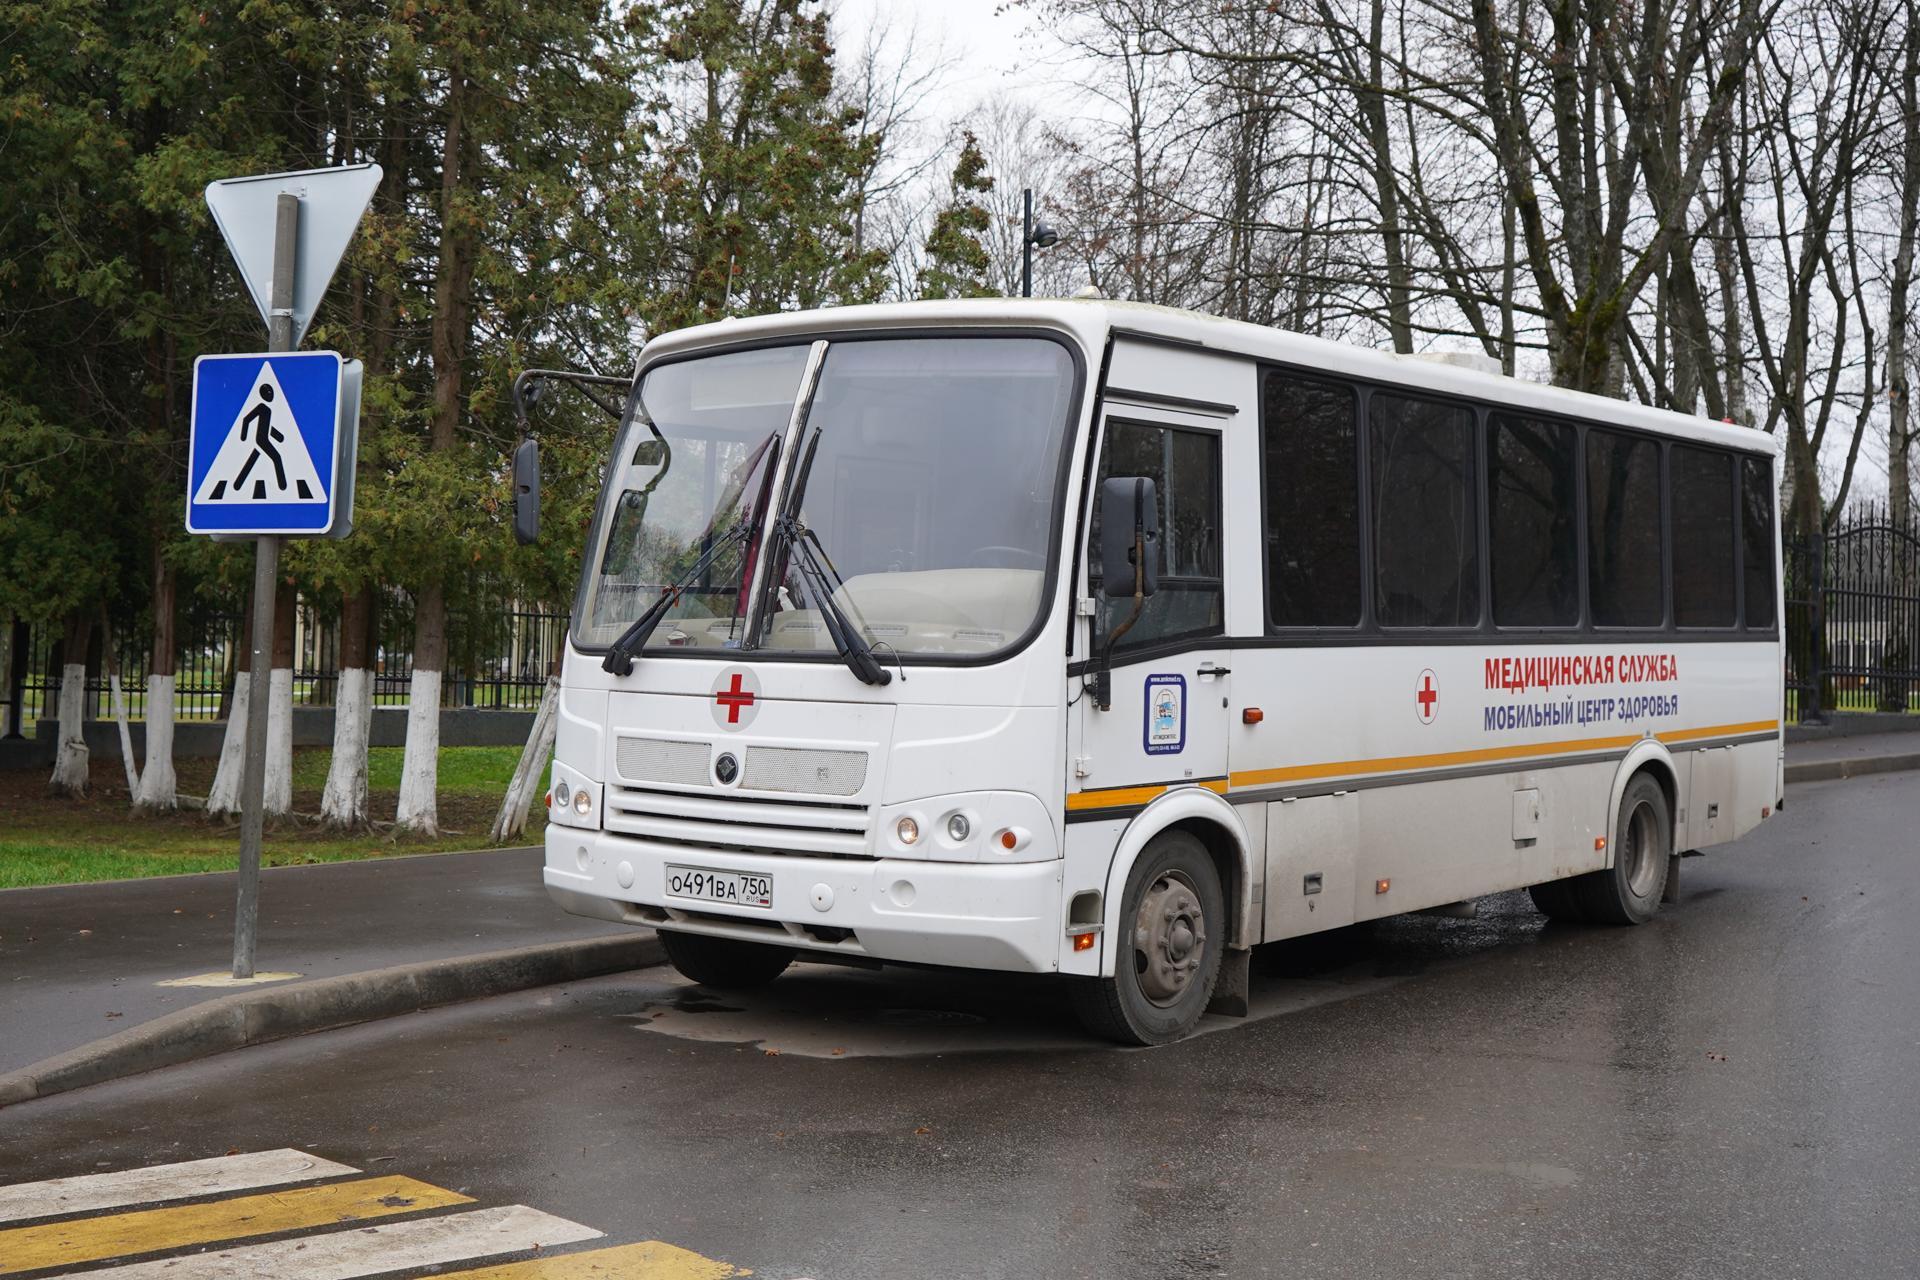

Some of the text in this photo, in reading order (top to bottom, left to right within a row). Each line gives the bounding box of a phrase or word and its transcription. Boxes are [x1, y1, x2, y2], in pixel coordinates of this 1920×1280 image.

[1485, 654, 1678, 694] МЕДИЦИНСКАЯ СЛУЖБА
[1484, 694, 1678, 731] МОБИЛЬНЫЙ ЦЕНТР ЗДОРОВЬЯ
[672, 872, 767, 899] О491ВА 750
